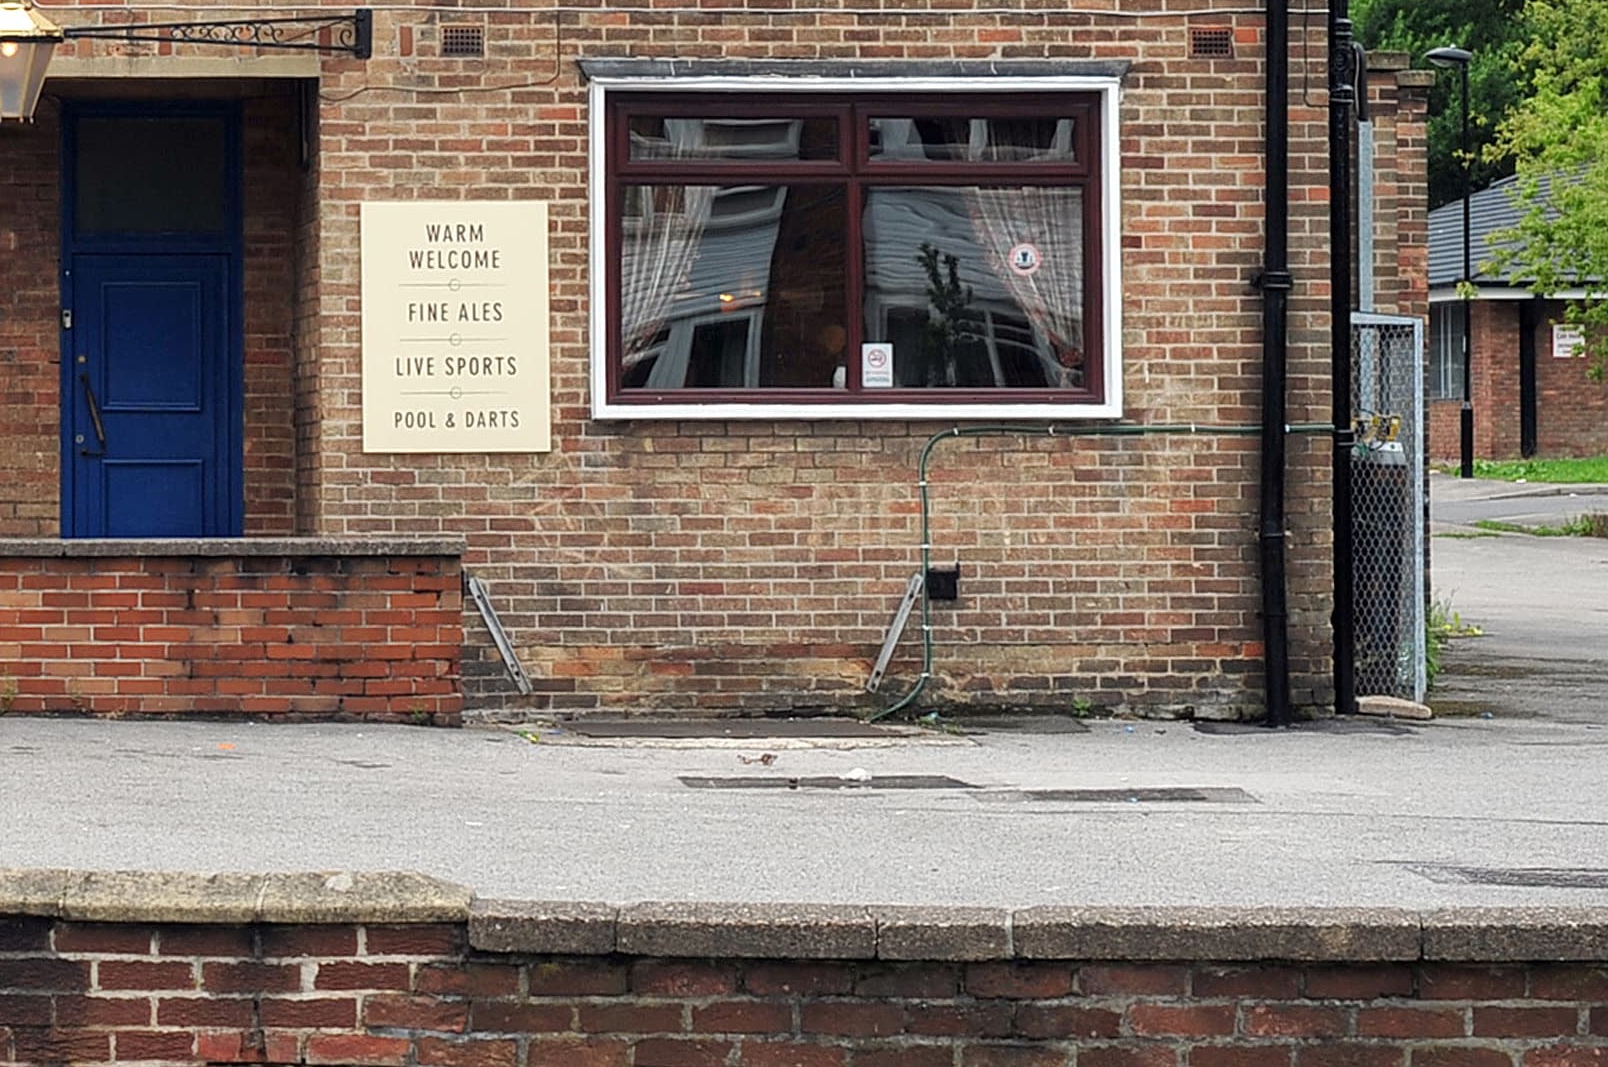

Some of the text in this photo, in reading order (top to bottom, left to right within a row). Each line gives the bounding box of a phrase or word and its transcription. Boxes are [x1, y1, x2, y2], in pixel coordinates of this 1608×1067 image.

[425, 223, 484, 243] WARM
[409, 250, 501, 270] WELCOME
[408, 302, 503, 322] FINE ALES
[396, 356, 517, 376] LIVE SPORTS
[394, 410, 520, 429] POOL & DARTS
